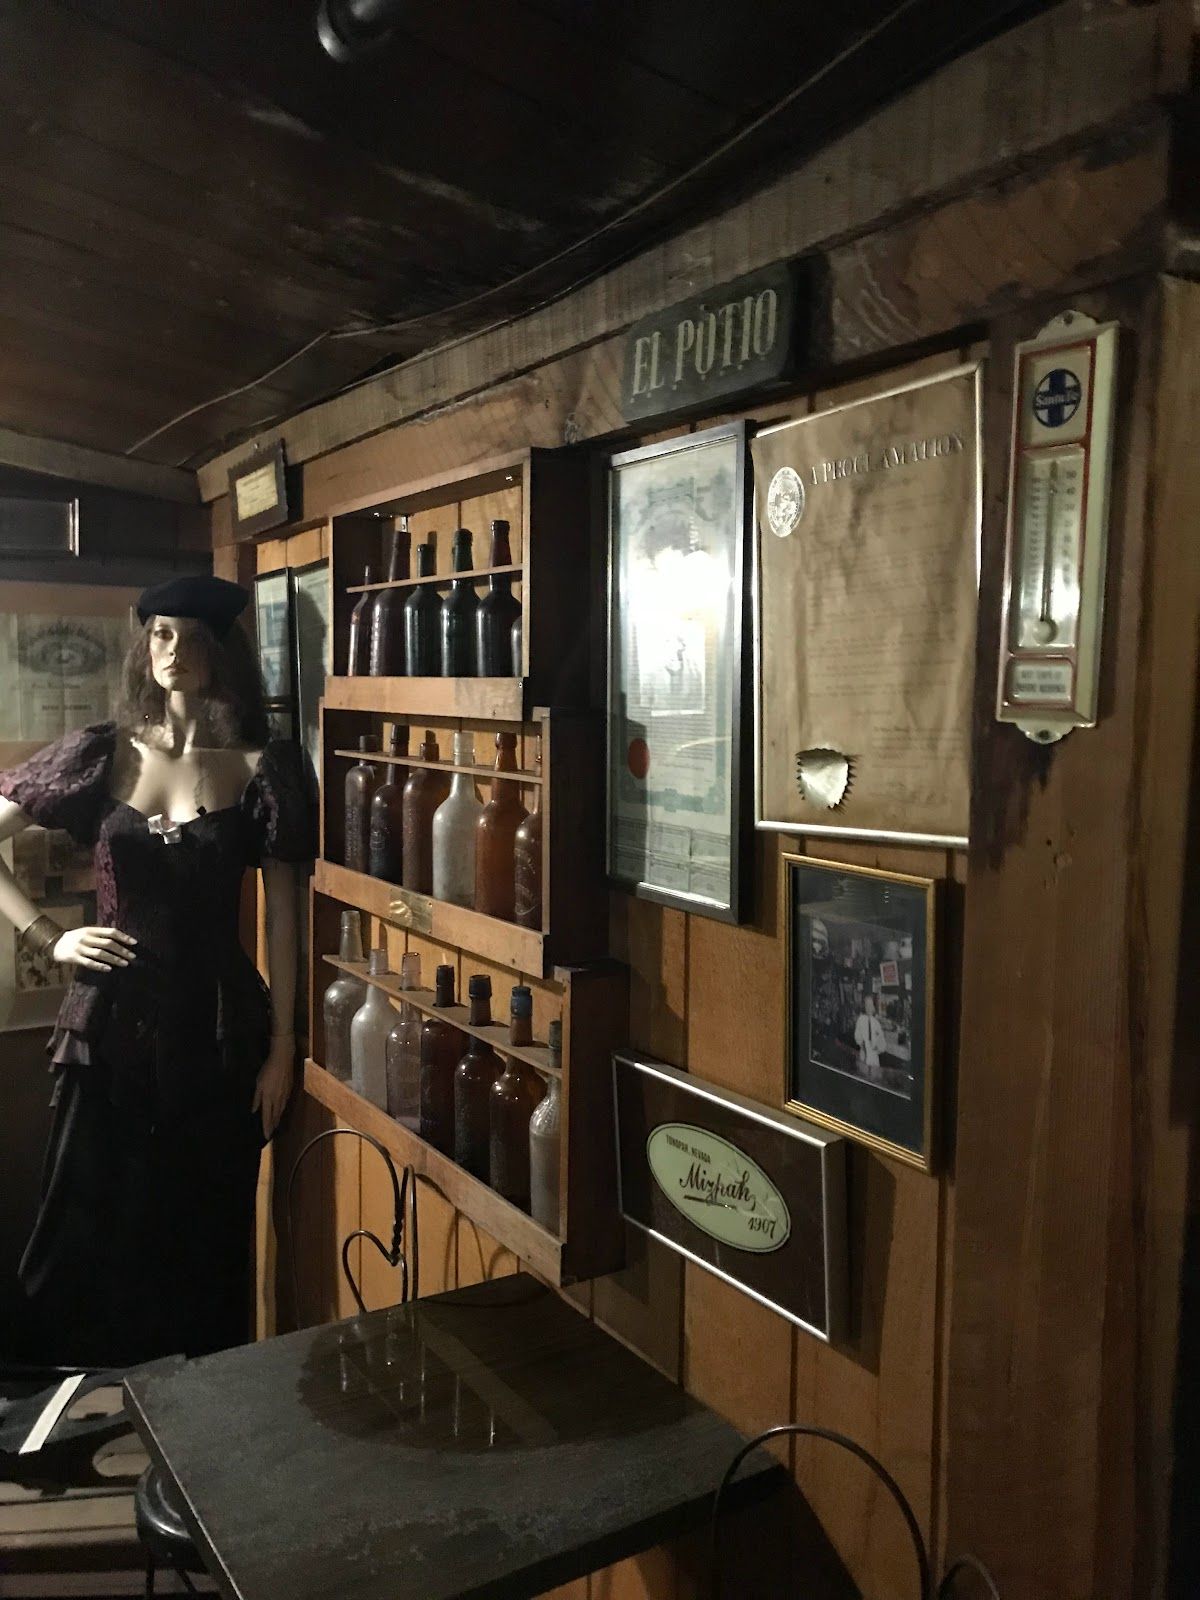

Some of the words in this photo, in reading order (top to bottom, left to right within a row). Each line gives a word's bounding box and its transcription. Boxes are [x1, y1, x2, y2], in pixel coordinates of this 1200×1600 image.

[631, 331, 664, 396] EL
[679, 1163, 756, 1211] Mizpah
[748, 1217, 776, 1239] 1907
